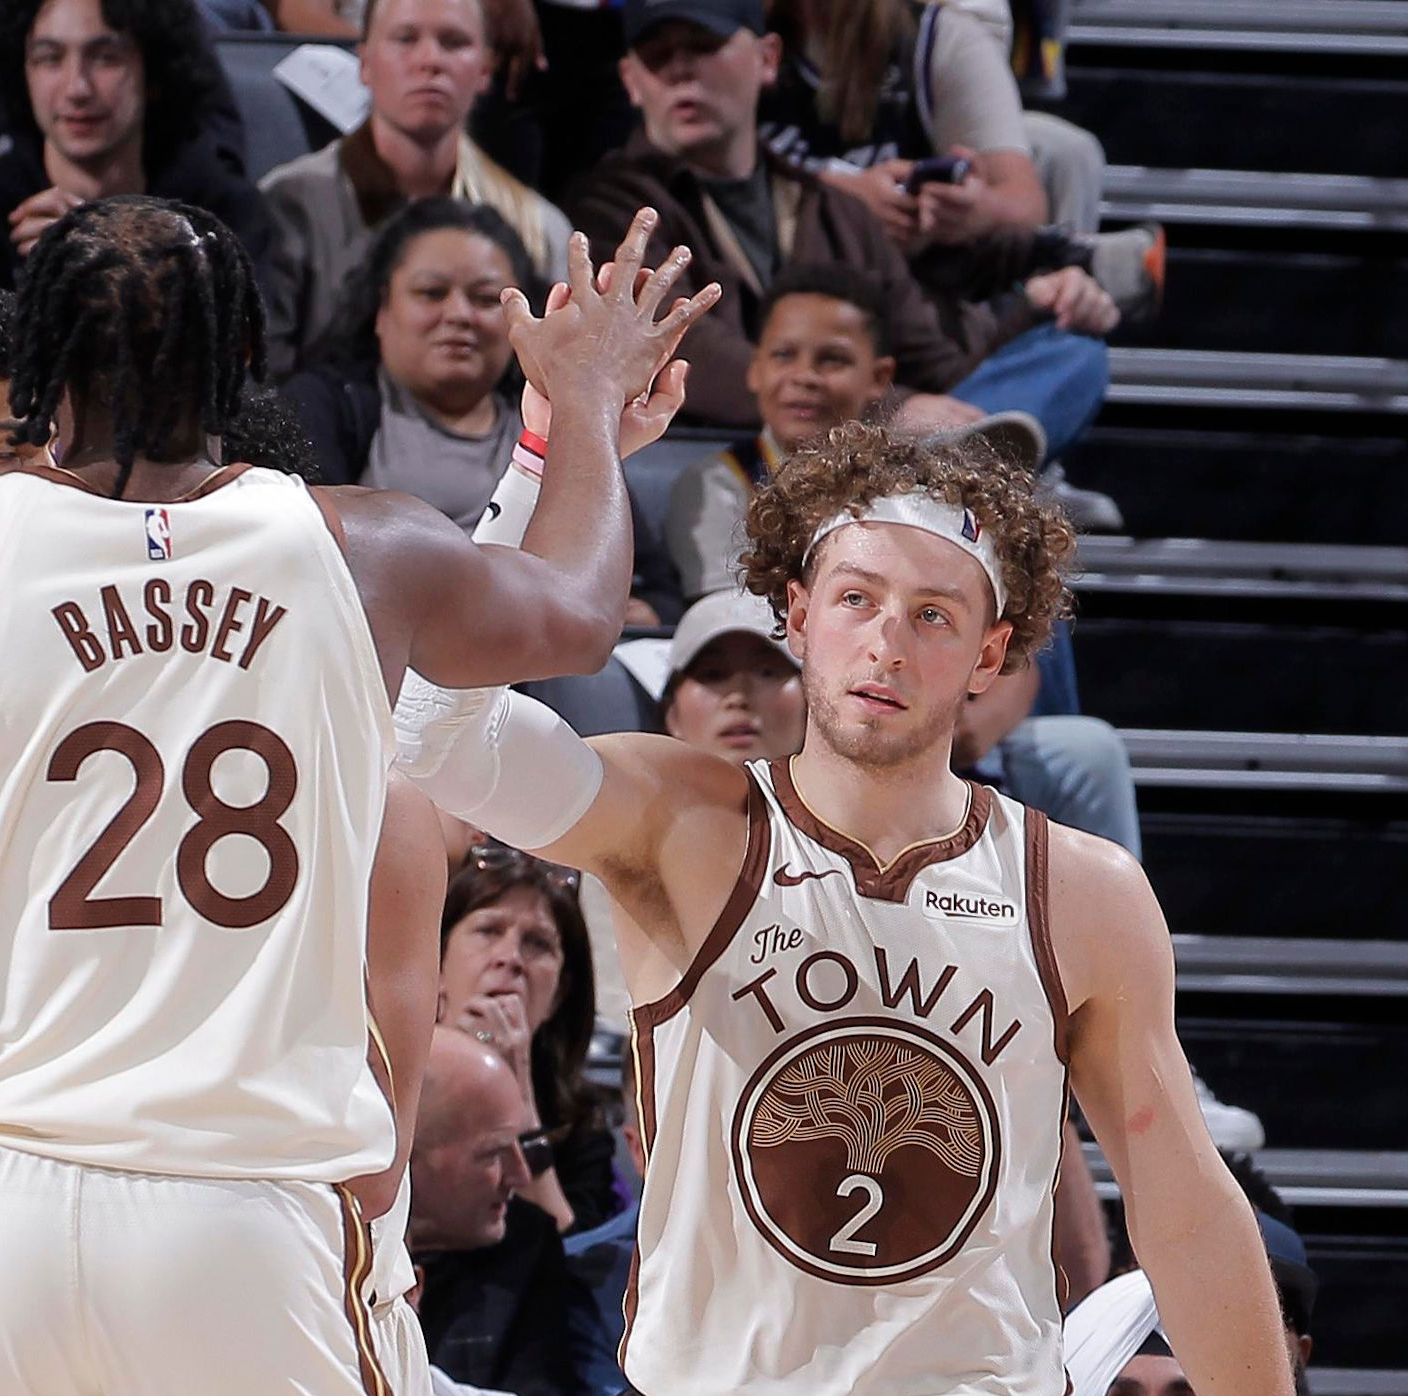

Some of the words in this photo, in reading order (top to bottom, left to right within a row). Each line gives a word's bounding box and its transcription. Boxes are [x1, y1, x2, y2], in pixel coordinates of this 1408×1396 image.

[51, 578, 288, 673] BASSEY
[46, 720, 299, 931] 28
[751, 924, 804, 964] The
[926, 890, 1015, 919] Rakuten
[732, 947, 1022, 1067] TOWN
[828, 1174, 885, 1257] 2
